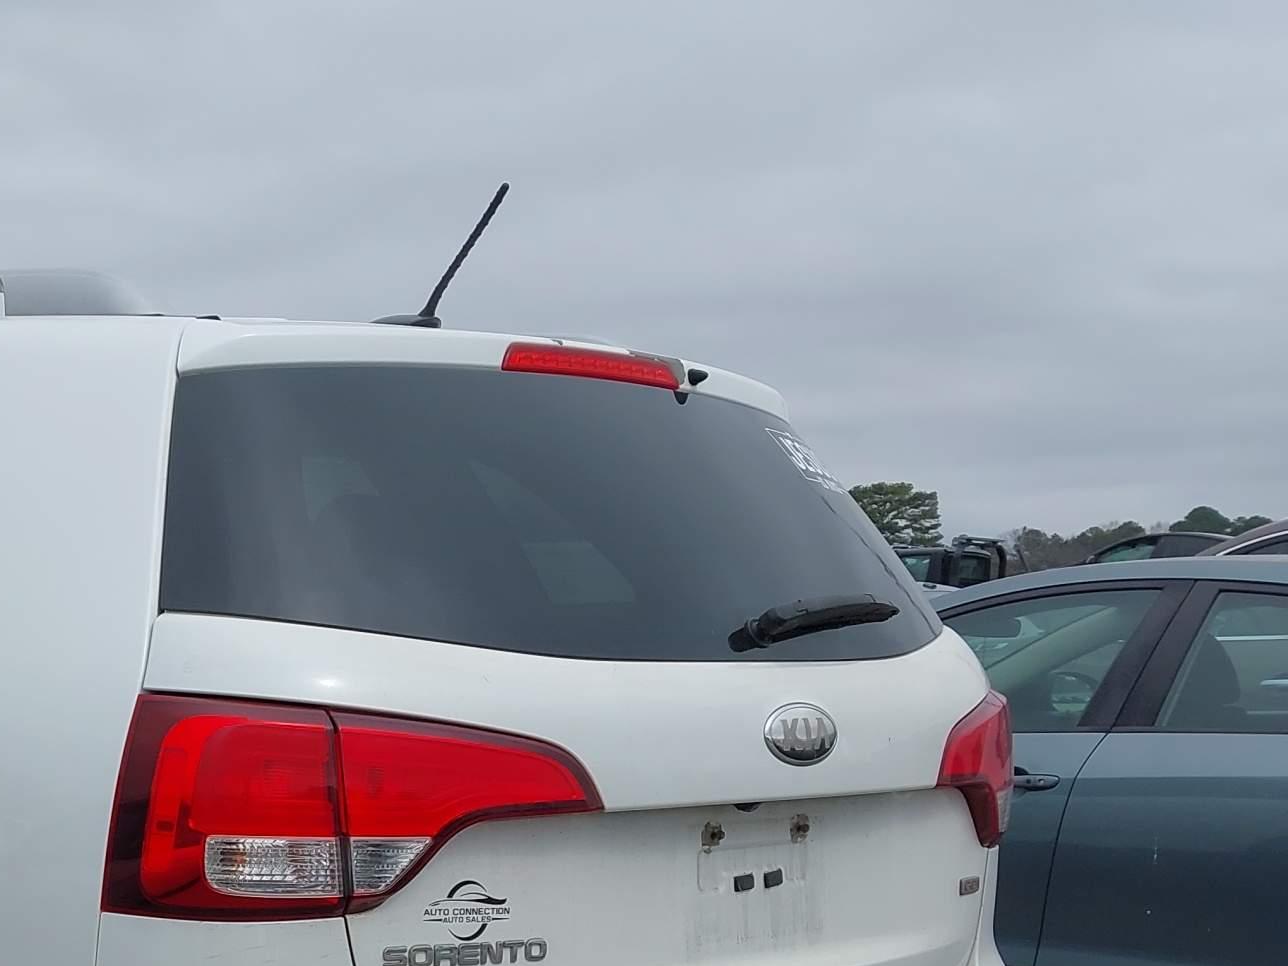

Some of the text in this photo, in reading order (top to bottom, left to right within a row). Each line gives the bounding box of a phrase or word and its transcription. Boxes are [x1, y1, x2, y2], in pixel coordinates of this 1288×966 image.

[780, 717, 831, 751] KIA
[424, 907, 510, 916] AUTO CONNECTION
[465, 915, 492, 923] SALES
